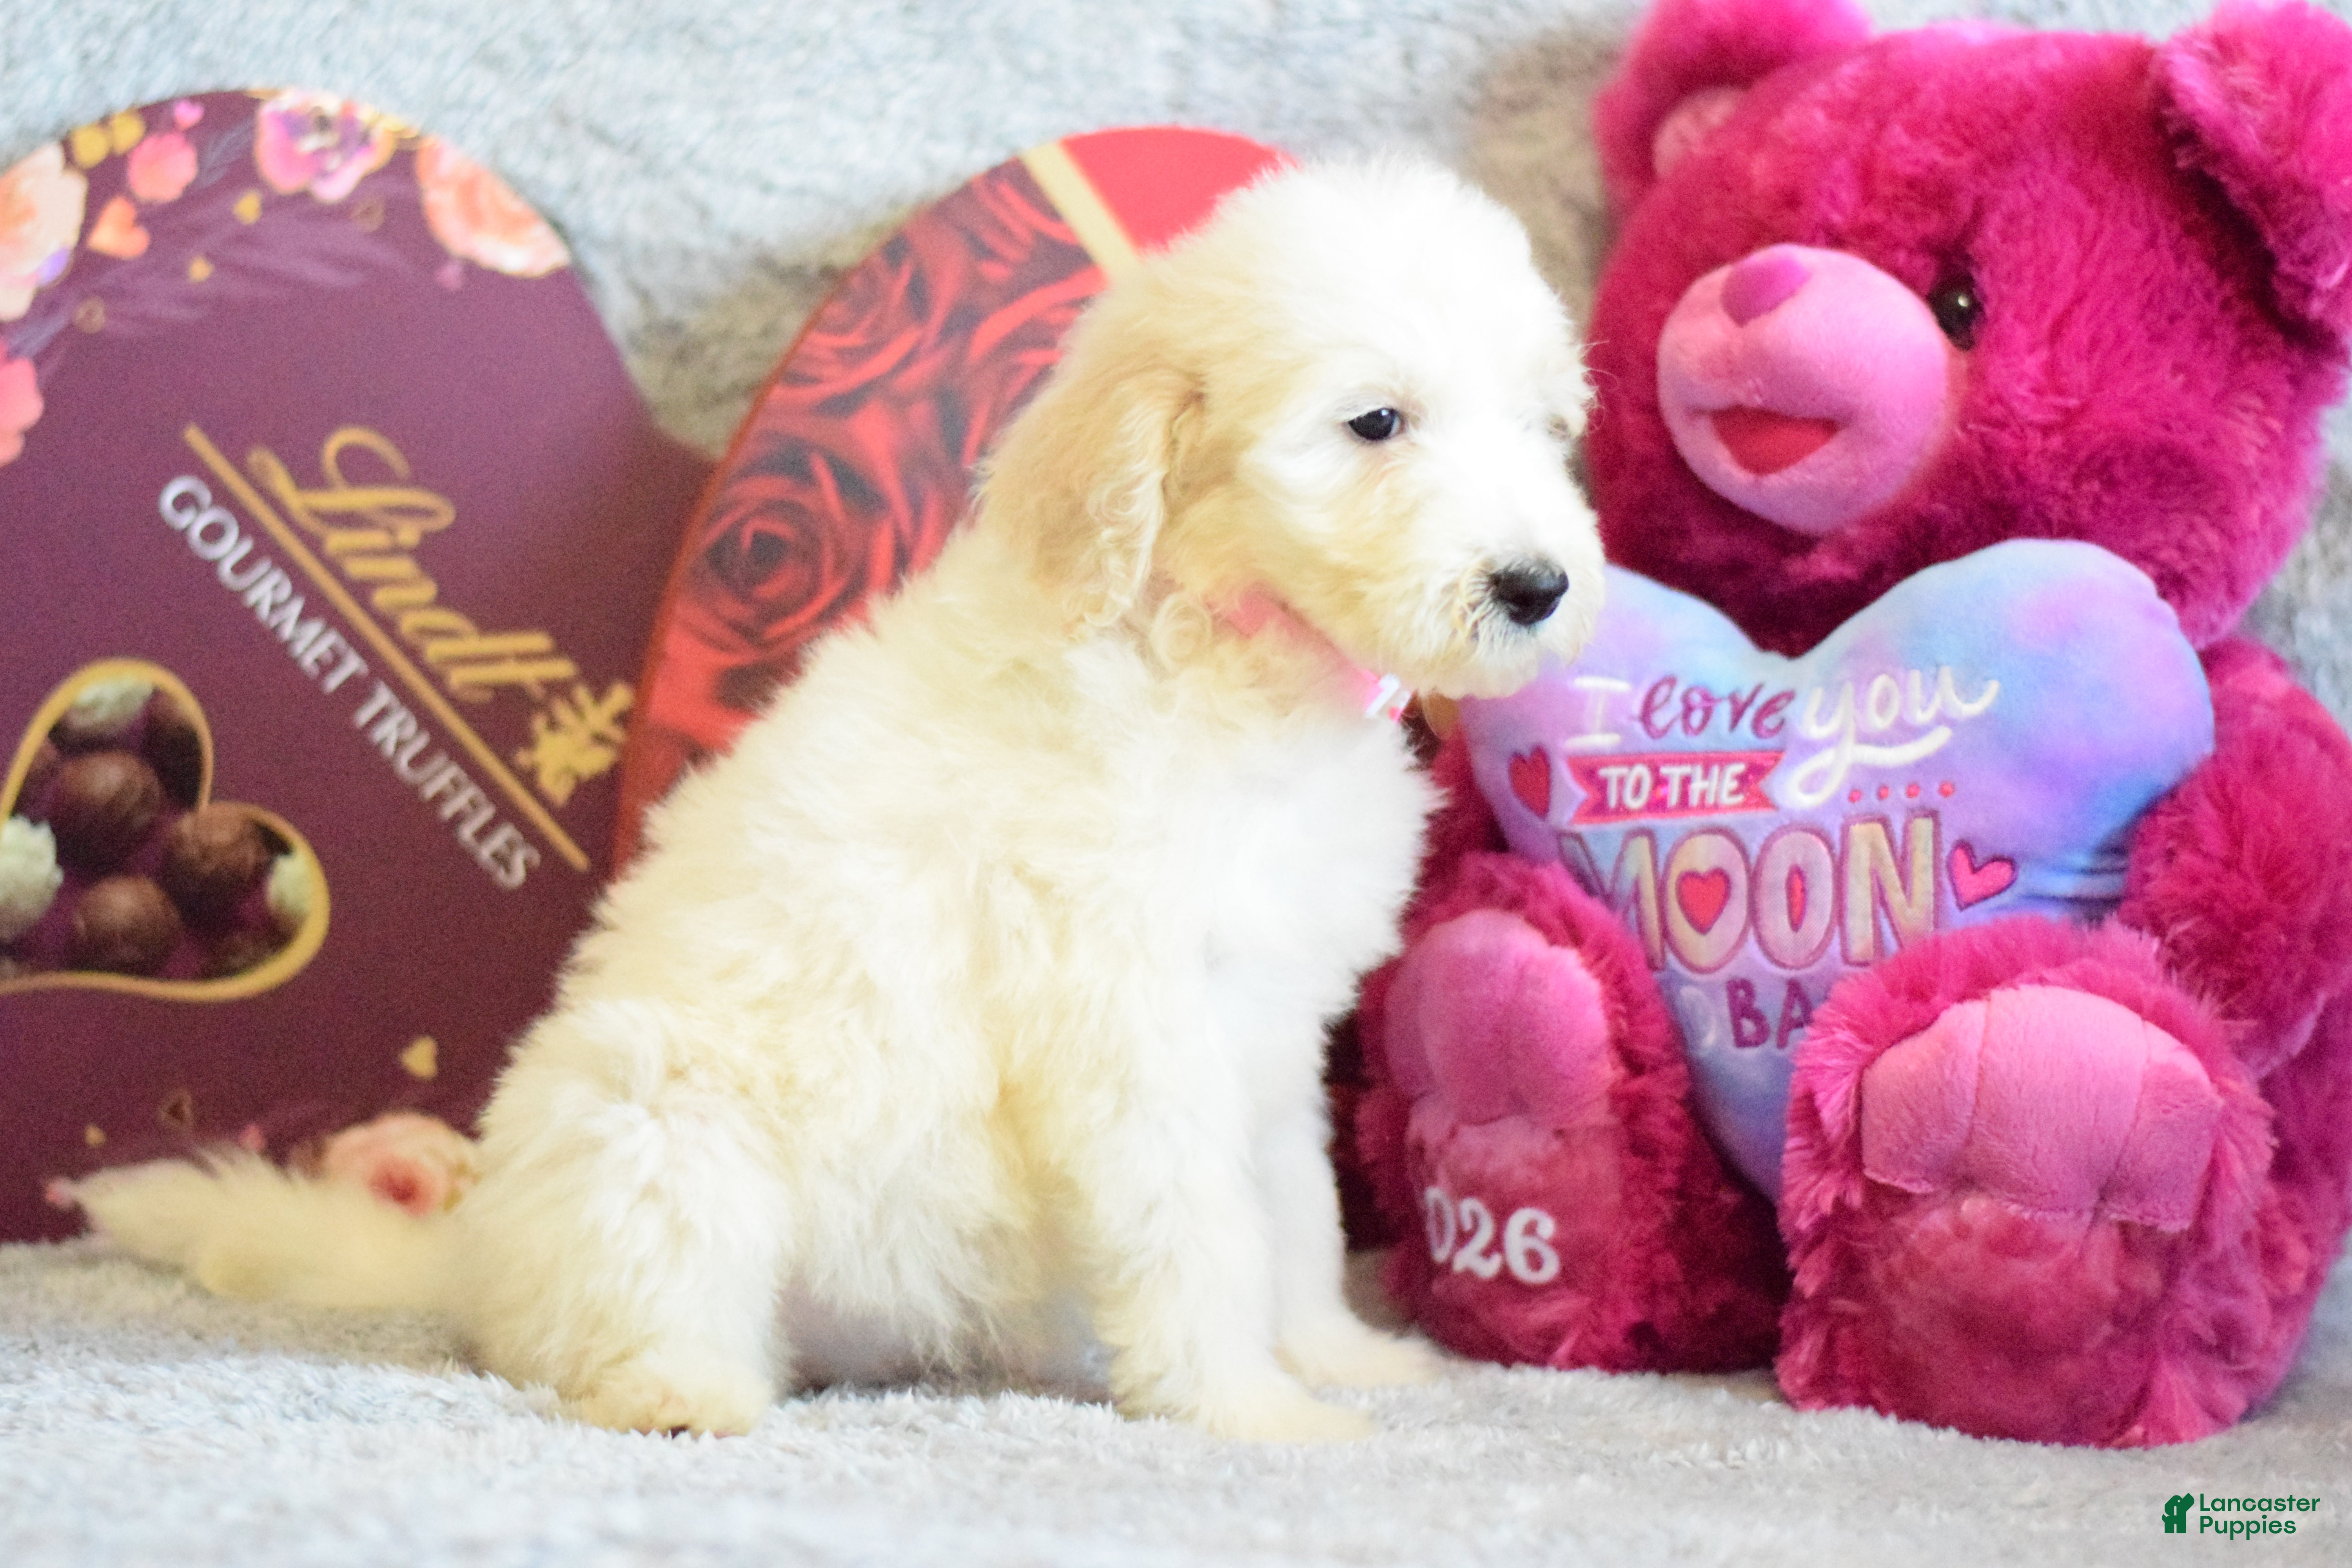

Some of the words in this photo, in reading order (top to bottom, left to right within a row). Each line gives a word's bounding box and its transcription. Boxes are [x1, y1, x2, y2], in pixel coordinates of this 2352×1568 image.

[247, 426, 579, 703] Lindt
[158, 475, 368, 694] GOURMET
[355, 679, 542, 889] TRUFFLES
[1566, 675, 1631, 749] I
[1634, 674, 1796, 740] love
[1786, 665, 2000, 810] you
[1599, 762, 1652, 810] TO
[1660, 762, 1746, 809] THE
[1726, 978, 1814, 1049] BA
[1425, 1186, 1560, 1284] 026
